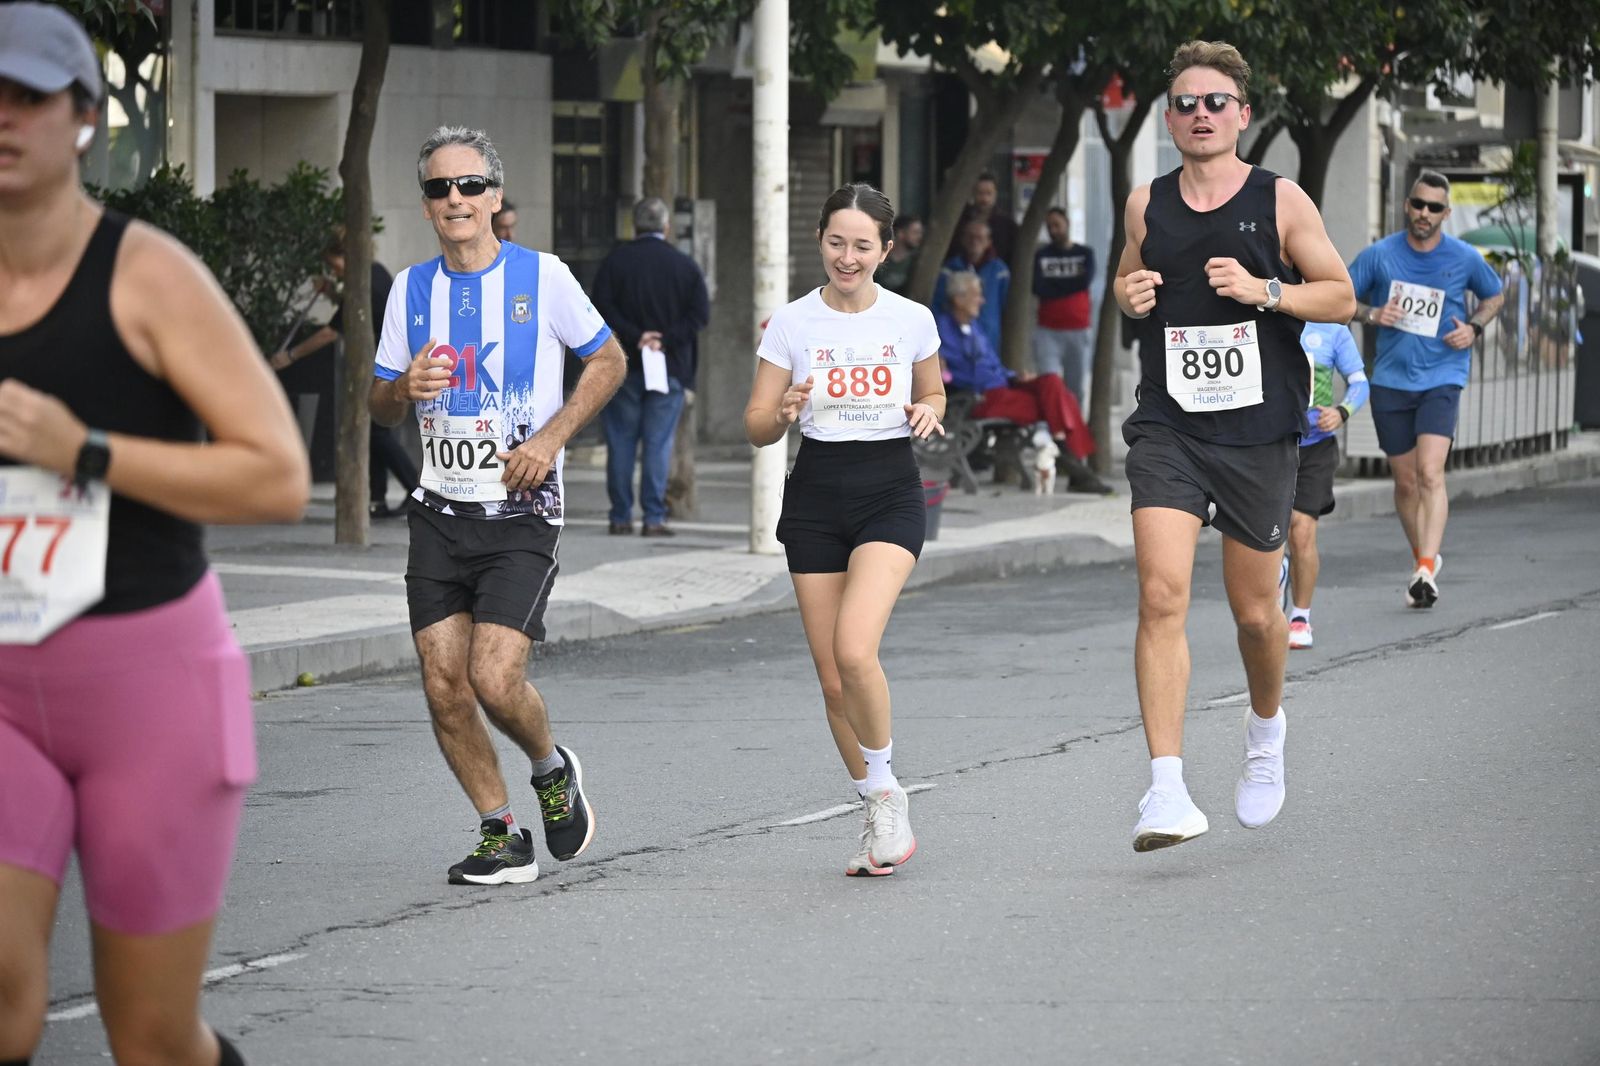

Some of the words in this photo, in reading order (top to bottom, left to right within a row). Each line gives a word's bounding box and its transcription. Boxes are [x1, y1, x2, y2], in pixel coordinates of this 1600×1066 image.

[1182, 347, 1244, 380] 890
[827, 365, 892, 398] 889
[432, 393, 499, 412] HUELVA
[1193, 393, 1233, 405] Huelva
[838, 410, 879, 421] Huelva
[425, 437, 499, 470] 1002
[440, 483, 474, 494] Huelva
